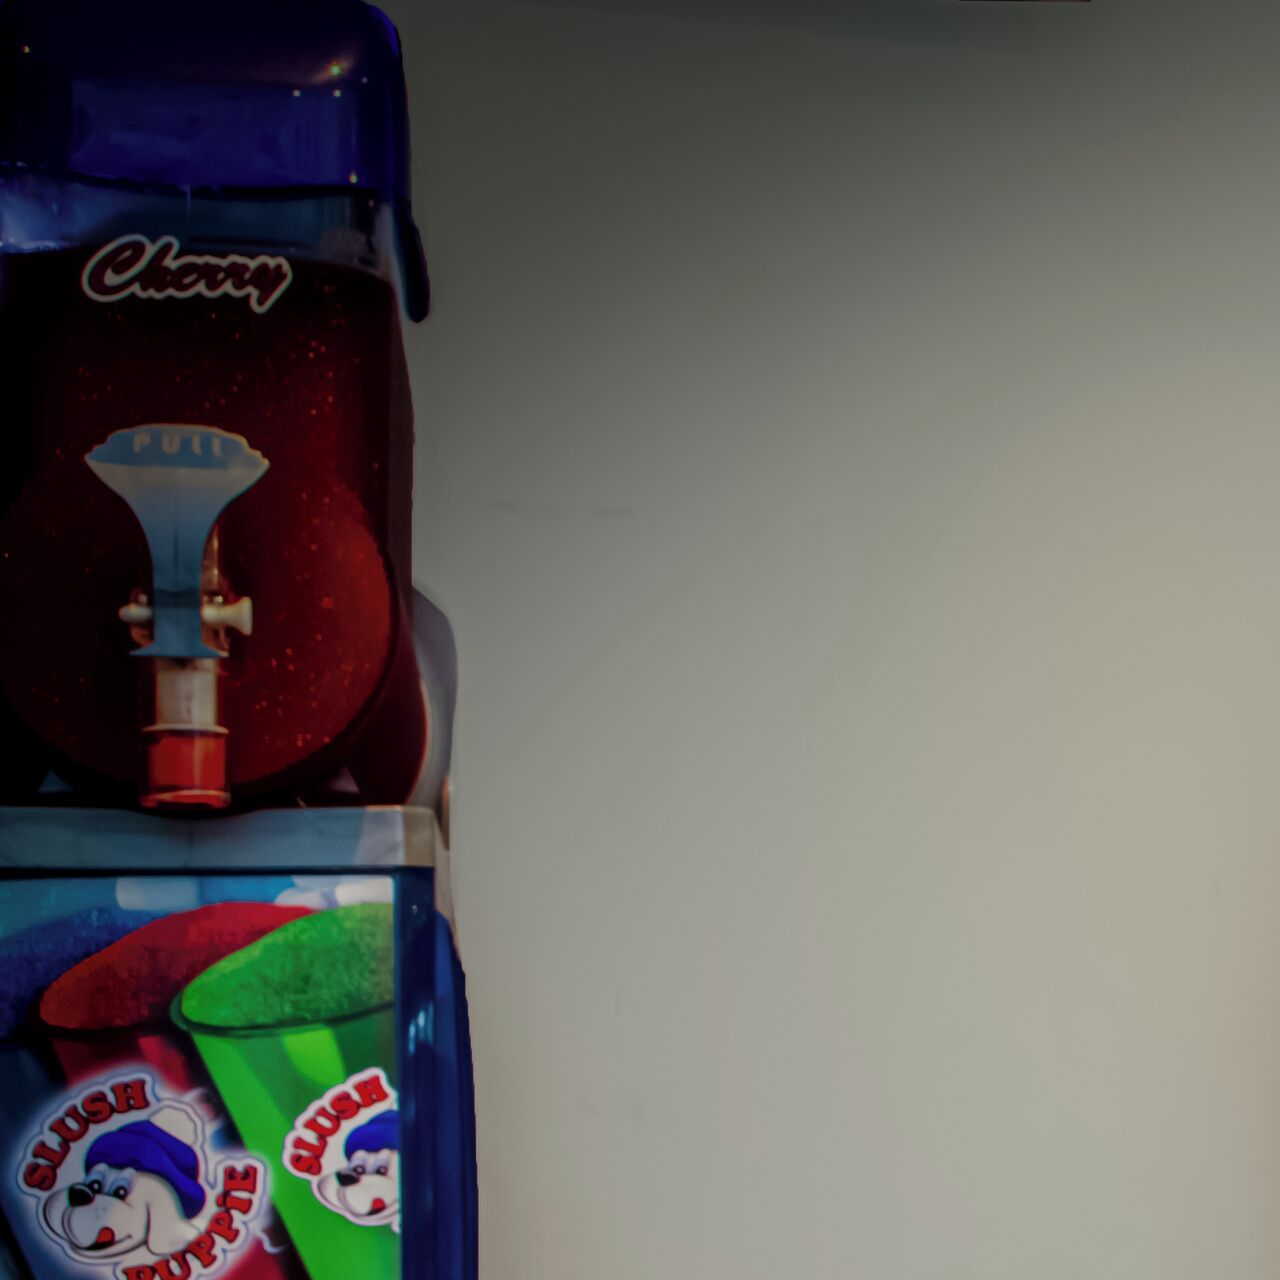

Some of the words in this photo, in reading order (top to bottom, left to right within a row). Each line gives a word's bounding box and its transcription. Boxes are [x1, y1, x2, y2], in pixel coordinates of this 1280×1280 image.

[82, 234, 292, 313] Cherry
[23, 1078, 150, 1191] SLUSH
[290, 1074, 390, 1176] SLUSH
